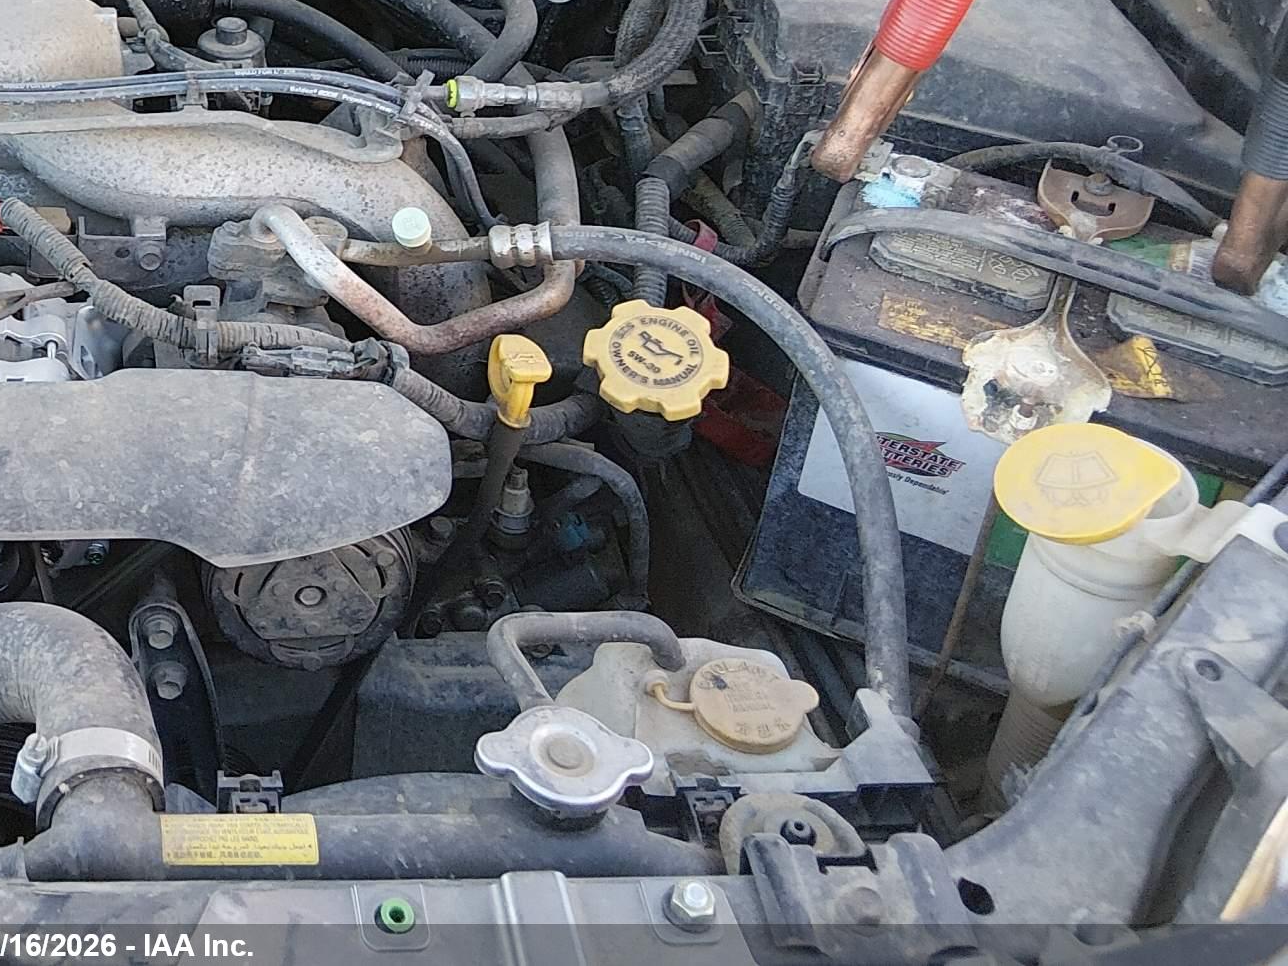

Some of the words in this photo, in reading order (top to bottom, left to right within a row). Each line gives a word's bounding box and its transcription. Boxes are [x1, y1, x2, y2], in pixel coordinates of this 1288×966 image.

[639, 317, 688, 337] ENGINE
[686, 338, 700, 356] OIL
[653, 363, 699, 386] MANUAL
[876, 435, 958, 470] TERSTATE
[879, 447, 952, 477] TTERIES
